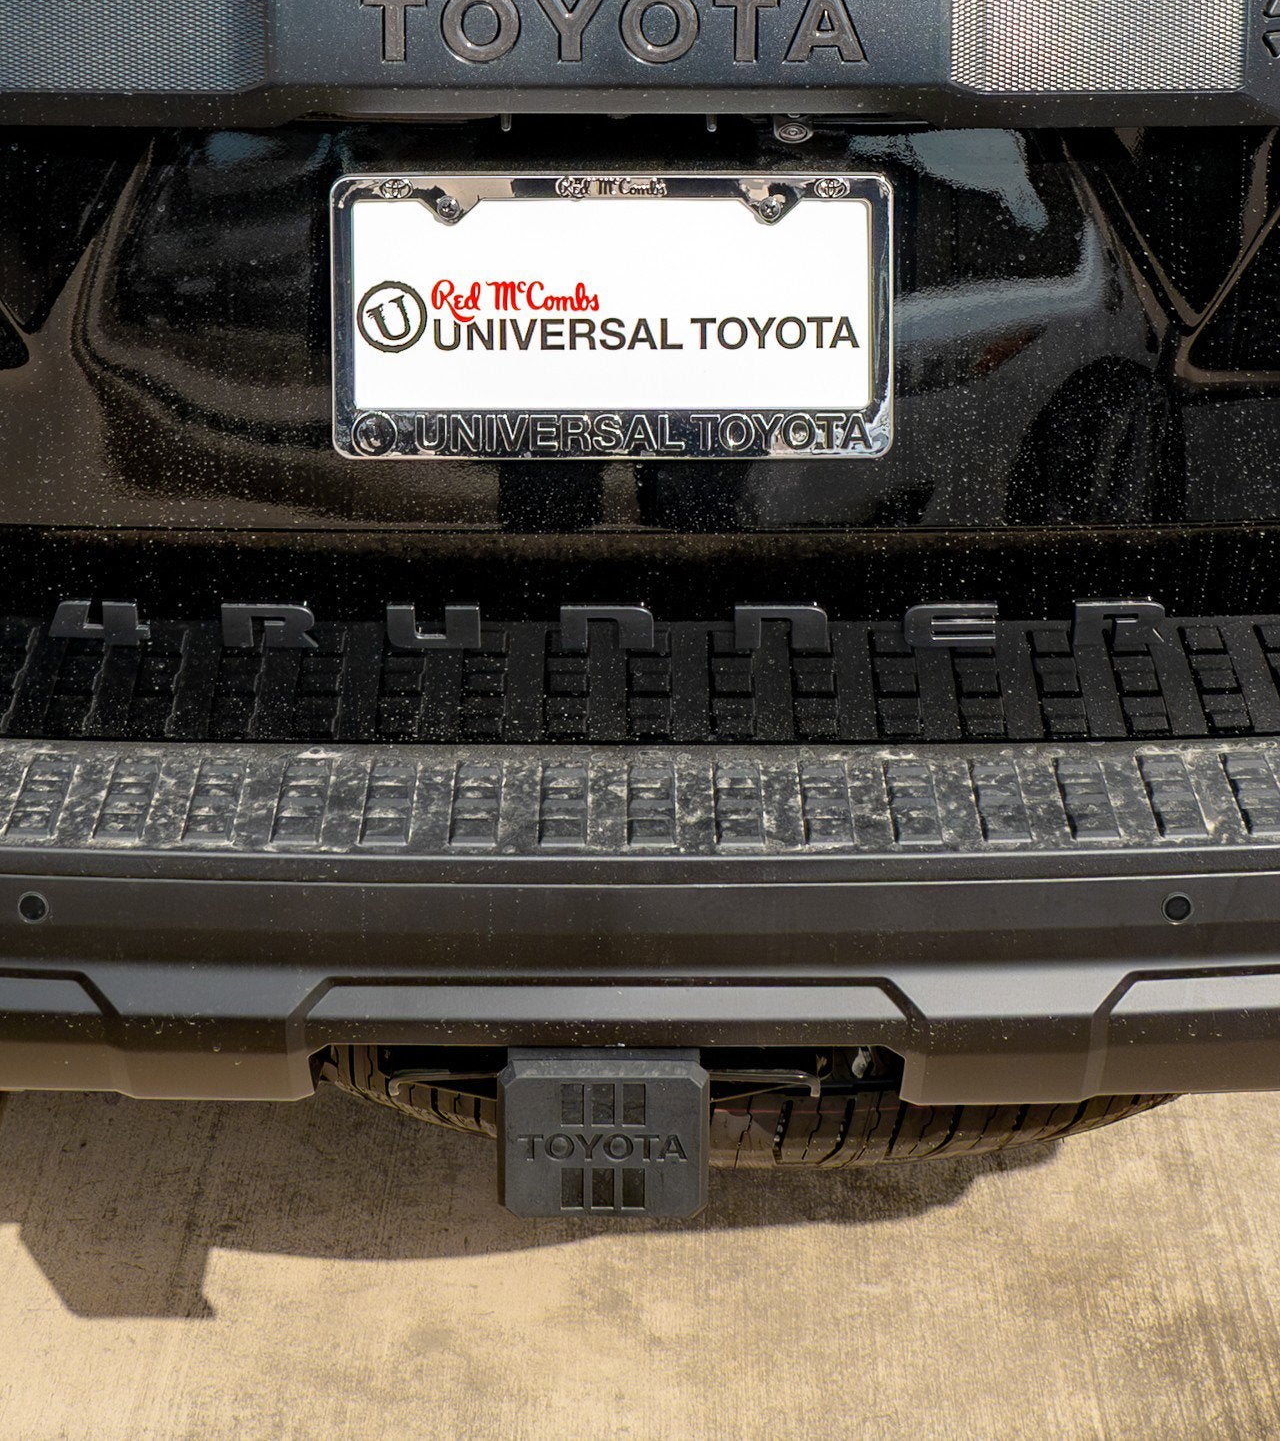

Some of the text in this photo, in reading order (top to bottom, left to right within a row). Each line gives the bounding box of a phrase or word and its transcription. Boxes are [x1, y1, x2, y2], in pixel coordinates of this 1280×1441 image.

[431, 280, 600, 321] Red McCombs
[433, 316, 860, 351] UNIVERSAL TOYOTA
[414, 414, 686, 453] UNIVERSAL
[690, 413, 873, 451] TOYOTA
[48, 599, 1167, 648] 4RUNNER
[517, 1133, 688, 1162] TOYOTA
